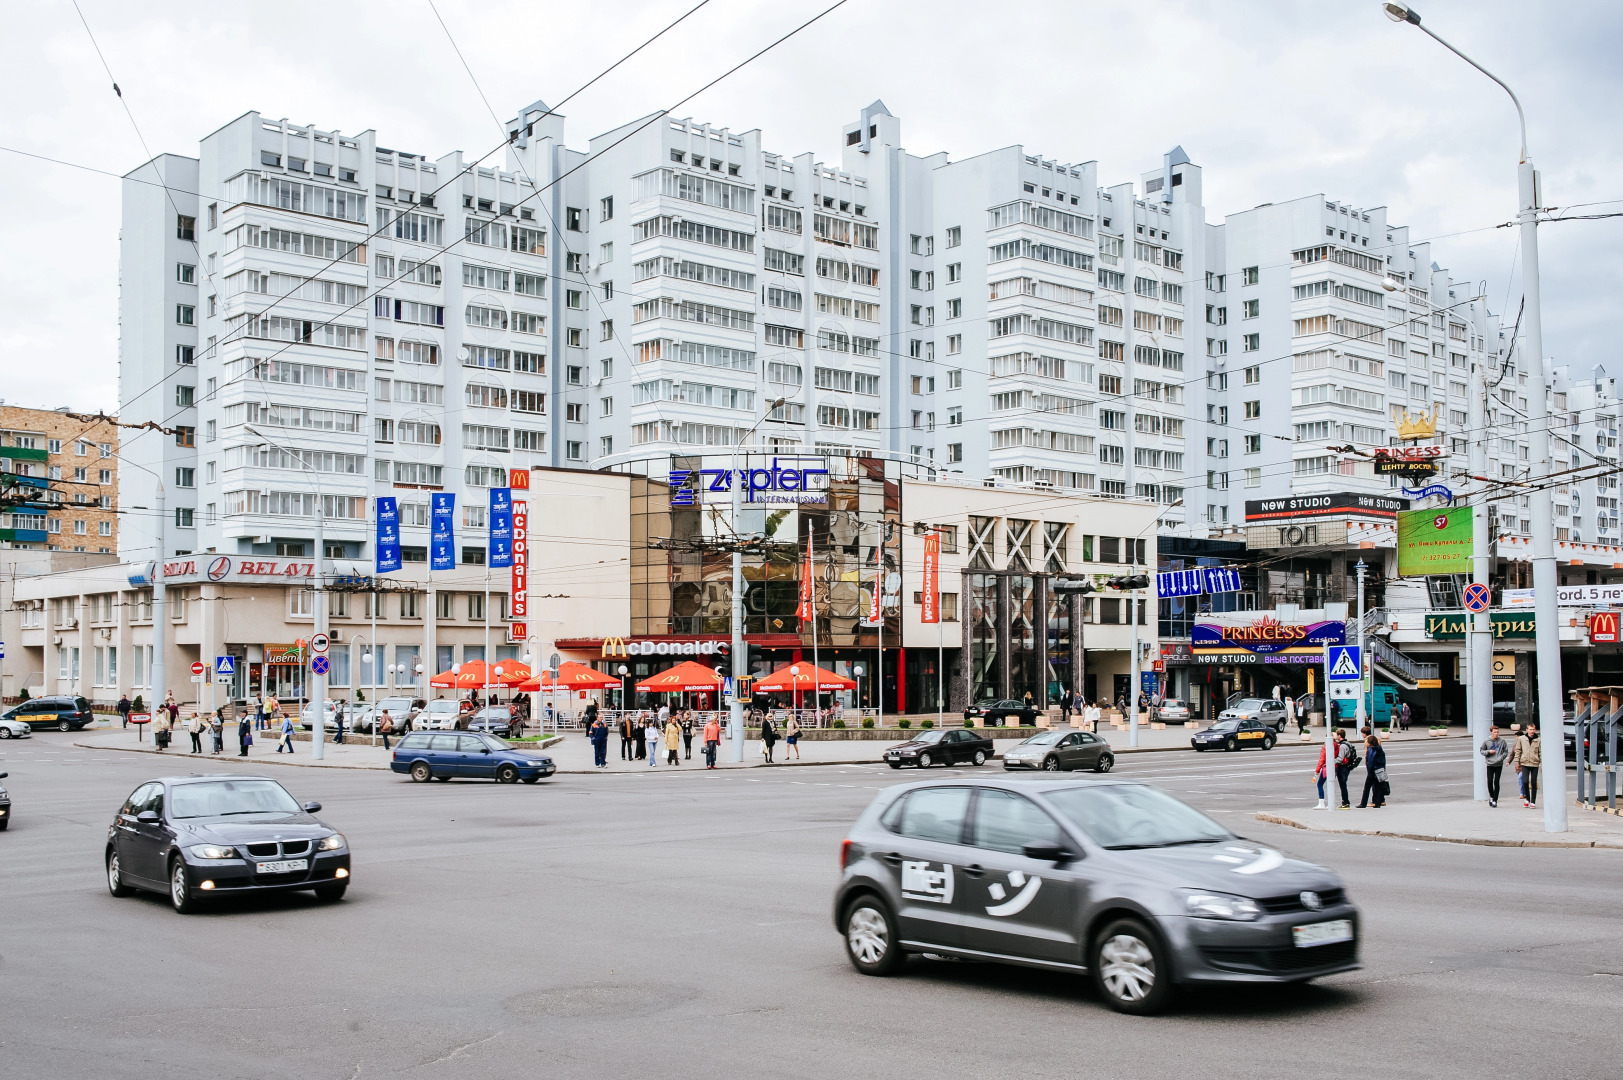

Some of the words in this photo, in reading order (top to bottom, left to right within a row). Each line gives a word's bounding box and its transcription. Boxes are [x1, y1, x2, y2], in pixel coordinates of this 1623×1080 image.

[1374, 446, 1441, 457] PRINCESS
[699, 457, 828, 503] zepter
[756, 495, 828, 504] INTERNATIONAL
[1290, 496, 1331, 509] STUDIO
[1376, 499, 1401, 510] STUDIO
[1435, 517, 1446, 527] S7
[1276, 525, 1317, 545] ТОП
[513, 502, 527, 615] McDonald's
[1557, 588, 1586, 600] ord.
[1590, 588, 1598, 600] 5
[1221, 625, 1307, 640] PRINCESS
[602, 636, 729, 658] McDonald's
[269, 654, 305, 664] цветы
[1222, 654, 1256, 663] STUDIO
[1264, 655, 1287, 664] вные
